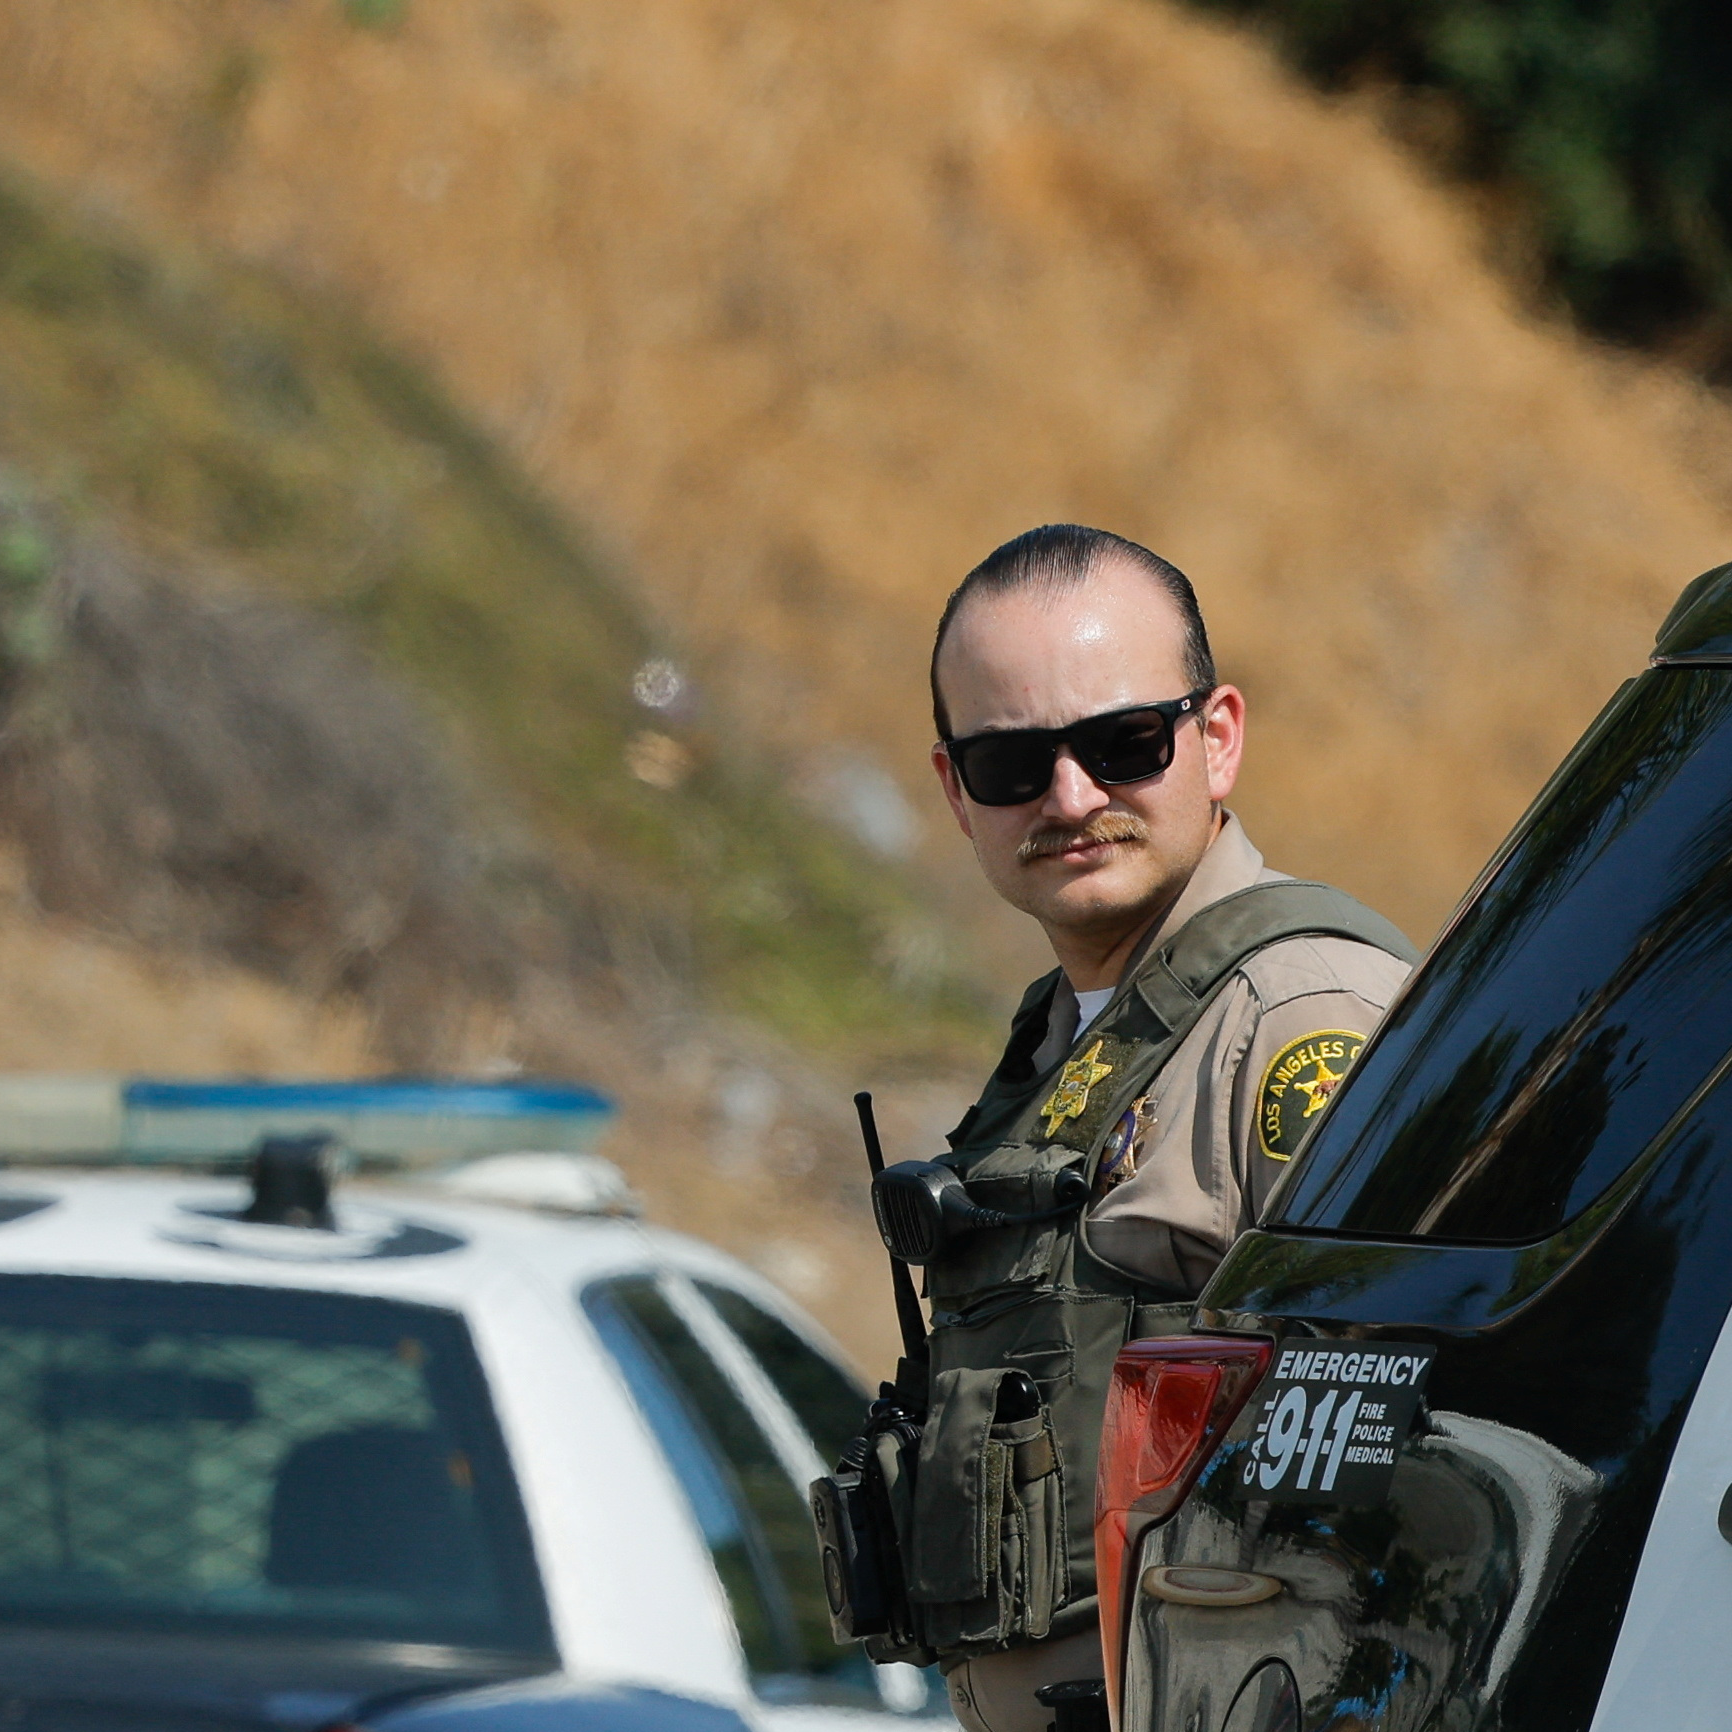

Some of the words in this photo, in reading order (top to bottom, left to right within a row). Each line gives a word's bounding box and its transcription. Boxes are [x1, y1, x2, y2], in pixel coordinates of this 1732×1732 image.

[1269, 1041, 1345, 1099] ANGELES
[1266, 1103, 1281, 1144] LOS
[1274, 1350, 1429, 1386] EMERGENCY
[1358, 1402, 1388, 1420] FIRE
[1243, 1389, 1281, 1485] CALL
[1351, 1424, 1395, 1443] POLICE
[1344, 1446, 1395, 1465] MEDICAL
